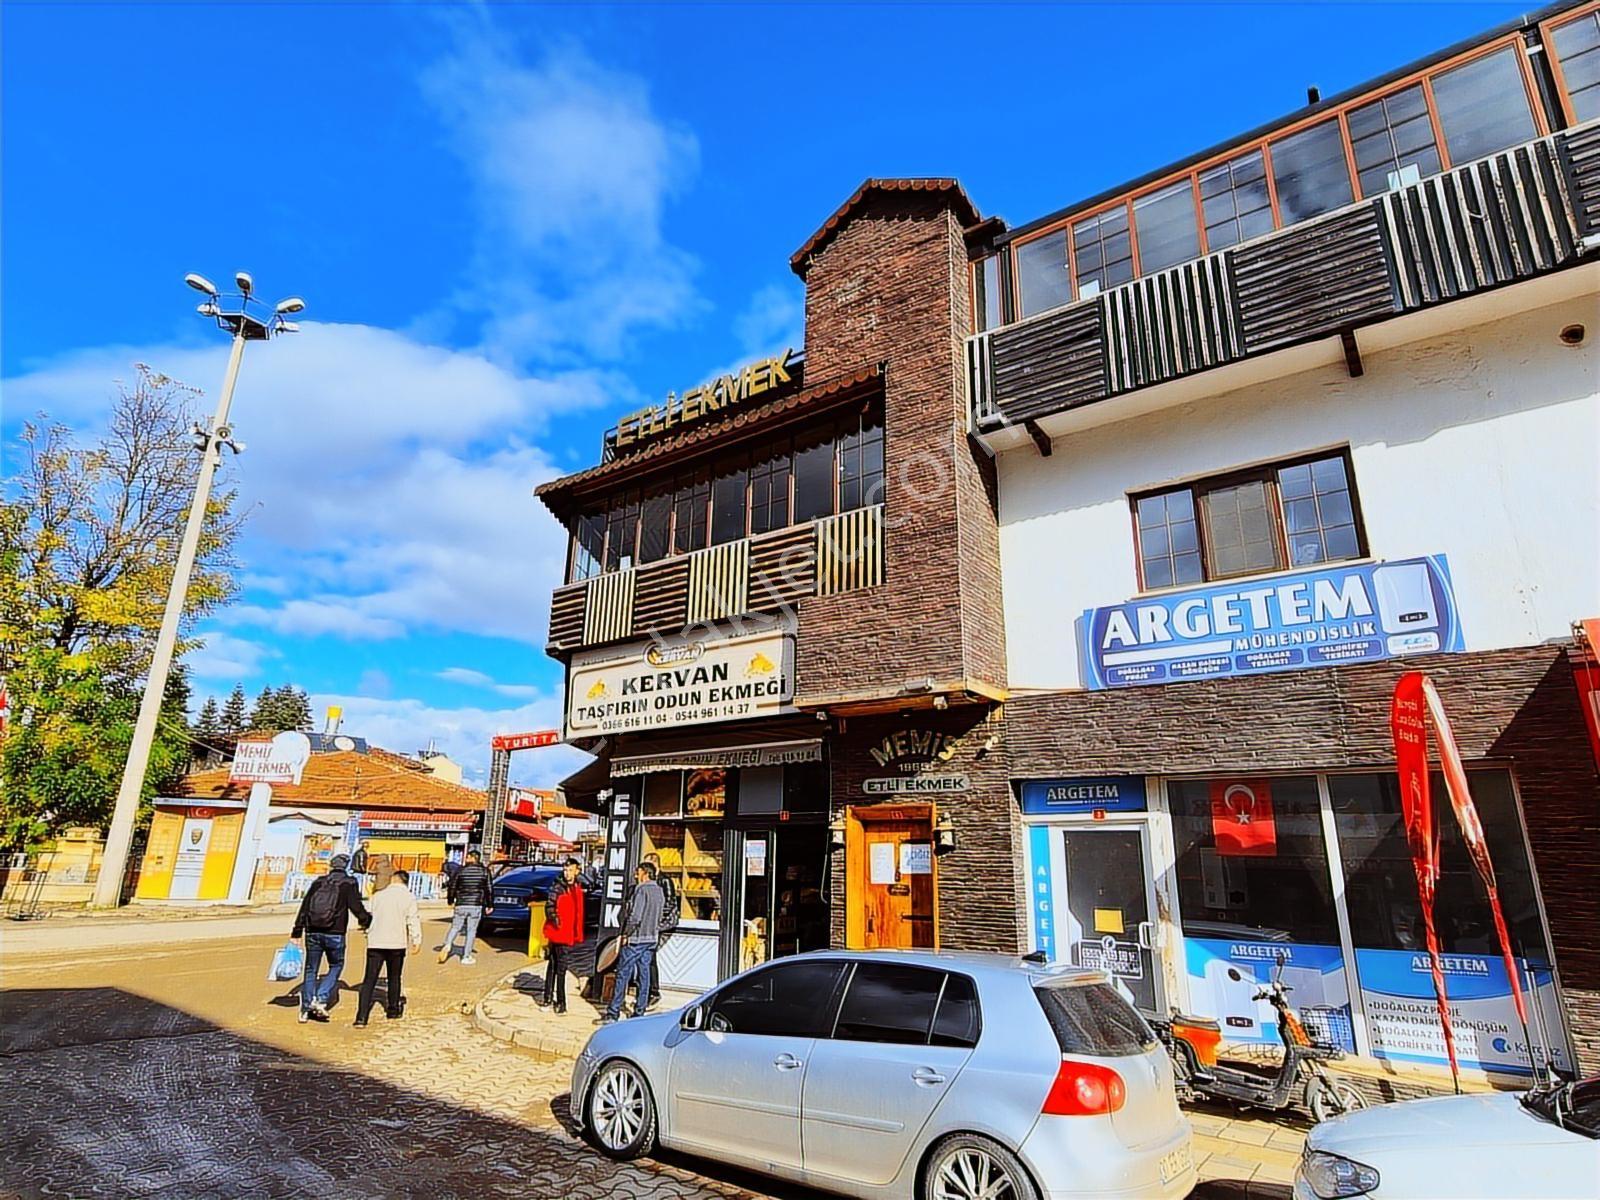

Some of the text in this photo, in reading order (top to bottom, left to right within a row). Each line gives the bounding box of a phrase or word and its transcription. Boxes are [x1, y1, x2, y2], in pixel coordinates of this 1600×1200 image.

[682, 348, 793, 422] EKMEK
[1102, 574, 1373, 649] ARGETEM
[1235, 621, 1377, 651] MÜHENDİSLİK
[621, 662, 729, 696] KERVAN
[577, 674, 787, 722] TAŞFIRIN ODUN EKMEĞİ
[624, 716, 640, 728] 616
[642, 715, 653, 726] 11
[656, 713, 668, 724] 04
[675, 709, 698, 722] 0544
[701, 706, 718, 719] 961
[722, 704, 734, 716] 14
[736, 703, 750, 715] 37
[257, 761, 292, 773] EKMEK
[905, 778, 966, 791] EKMEK
[1047, 784, 1119, 800] ARGETEM
[603, 794, 631, 928] EKMEK
[1037, 865, 1050, 962] ARGET
[1229, 944, 1293, 958] ARGETEM
[1452, 1019, 1509, 1034] DÖNÜŞÜM
